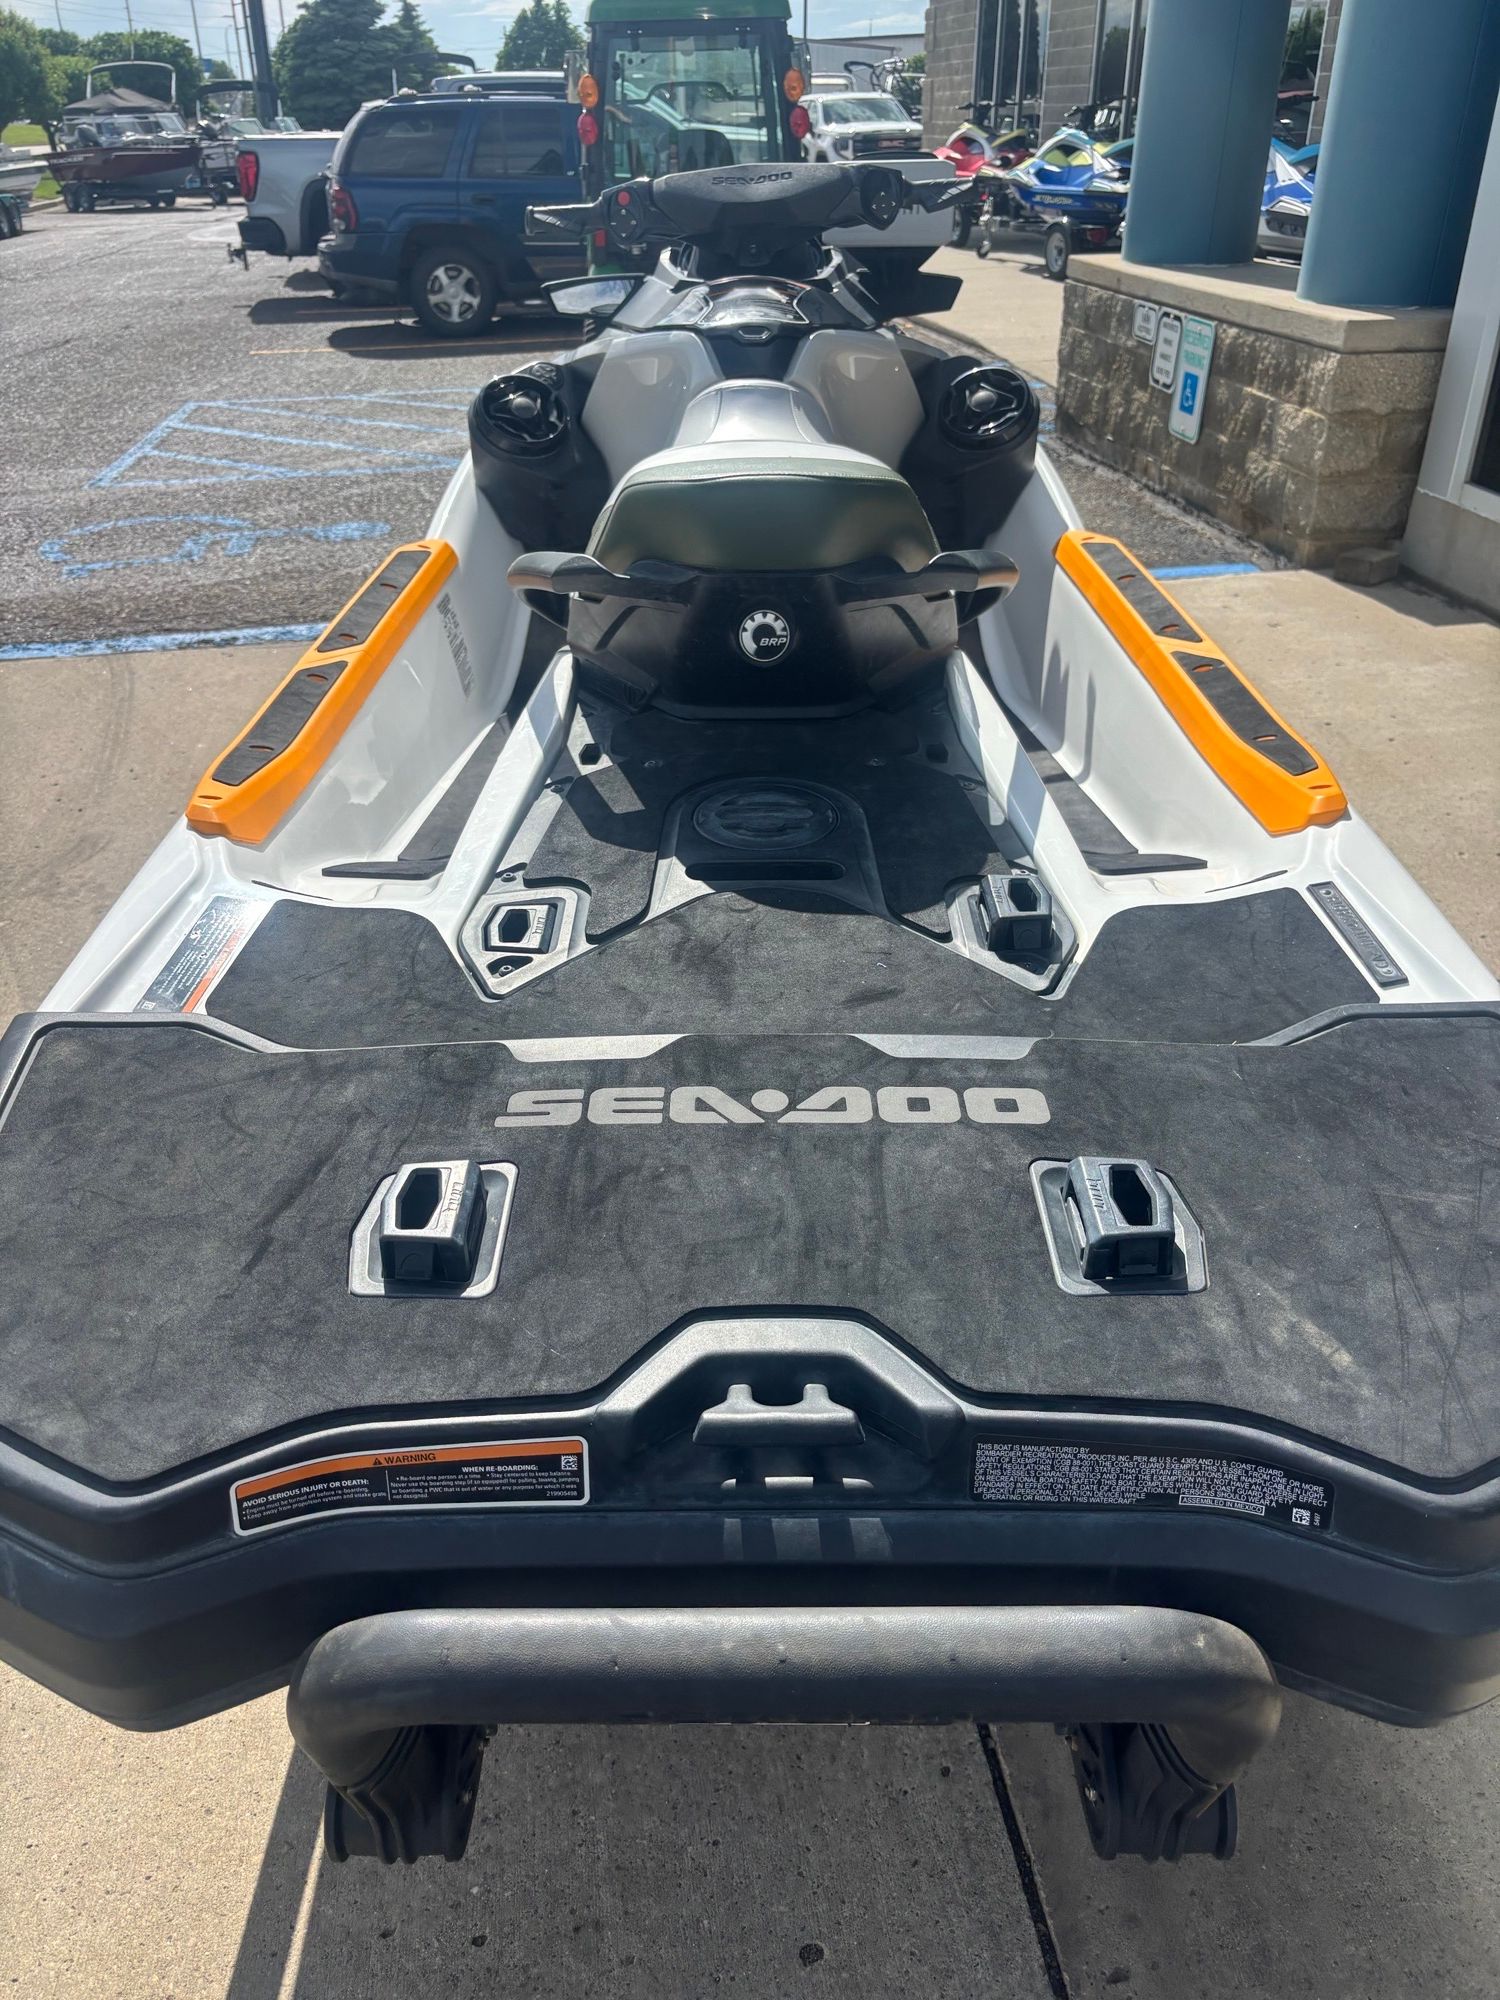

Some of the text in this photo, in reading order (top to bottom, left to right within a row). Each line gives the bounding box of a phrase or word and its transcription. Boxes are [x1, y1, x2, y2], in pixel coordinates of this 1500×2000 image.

[760, 638, 786, 646] BRP
[1022, 1445, 1078, 1453] MANUFACTURED
[384, 1453, 436, 1464] WARNING
[1023, 1451, 1075, 1459] RECREATIONAL
[1231, 1461, 1256, 1471] COAST
[1258, 1466, 1283, 1477] GUARD
[1173, 1470, 1223, 1478] REGULATIONS
[1240, 1476, 1291, 1492] INAPPLICABLE
[1302, 1490, 1324, 1500] LIGHT
[1219, 1467, 1246, 1476] VESSEL
[1248, 1471, 1270, 1480] FROM
[1302, 1483, 1324, 1493] MORE
[242, 1497, 266, 1507] AVOID
[268, 1490, 300, 1502] SERIOUS
[301, 1484, 328, 1494] INJURY
[1217, 1490, 1246, 1501] SHOULD
[1249, 1497, 1270, 1507] WEAR
[1231, 1481, 1249, 1489] HAVE
[1263, 1487, 1296, 1500] ADVERSE
[1299, 1496, 1327, 1507] EFFECT
[1237, 1488, 1263, 1498] GUARD
[1265, 1493, 1293, 1505] SAFETY
[1182, 1497, 1224, 1506] ASSEMBLED
[1235, 1502, 1262, 1512] MEXICO
